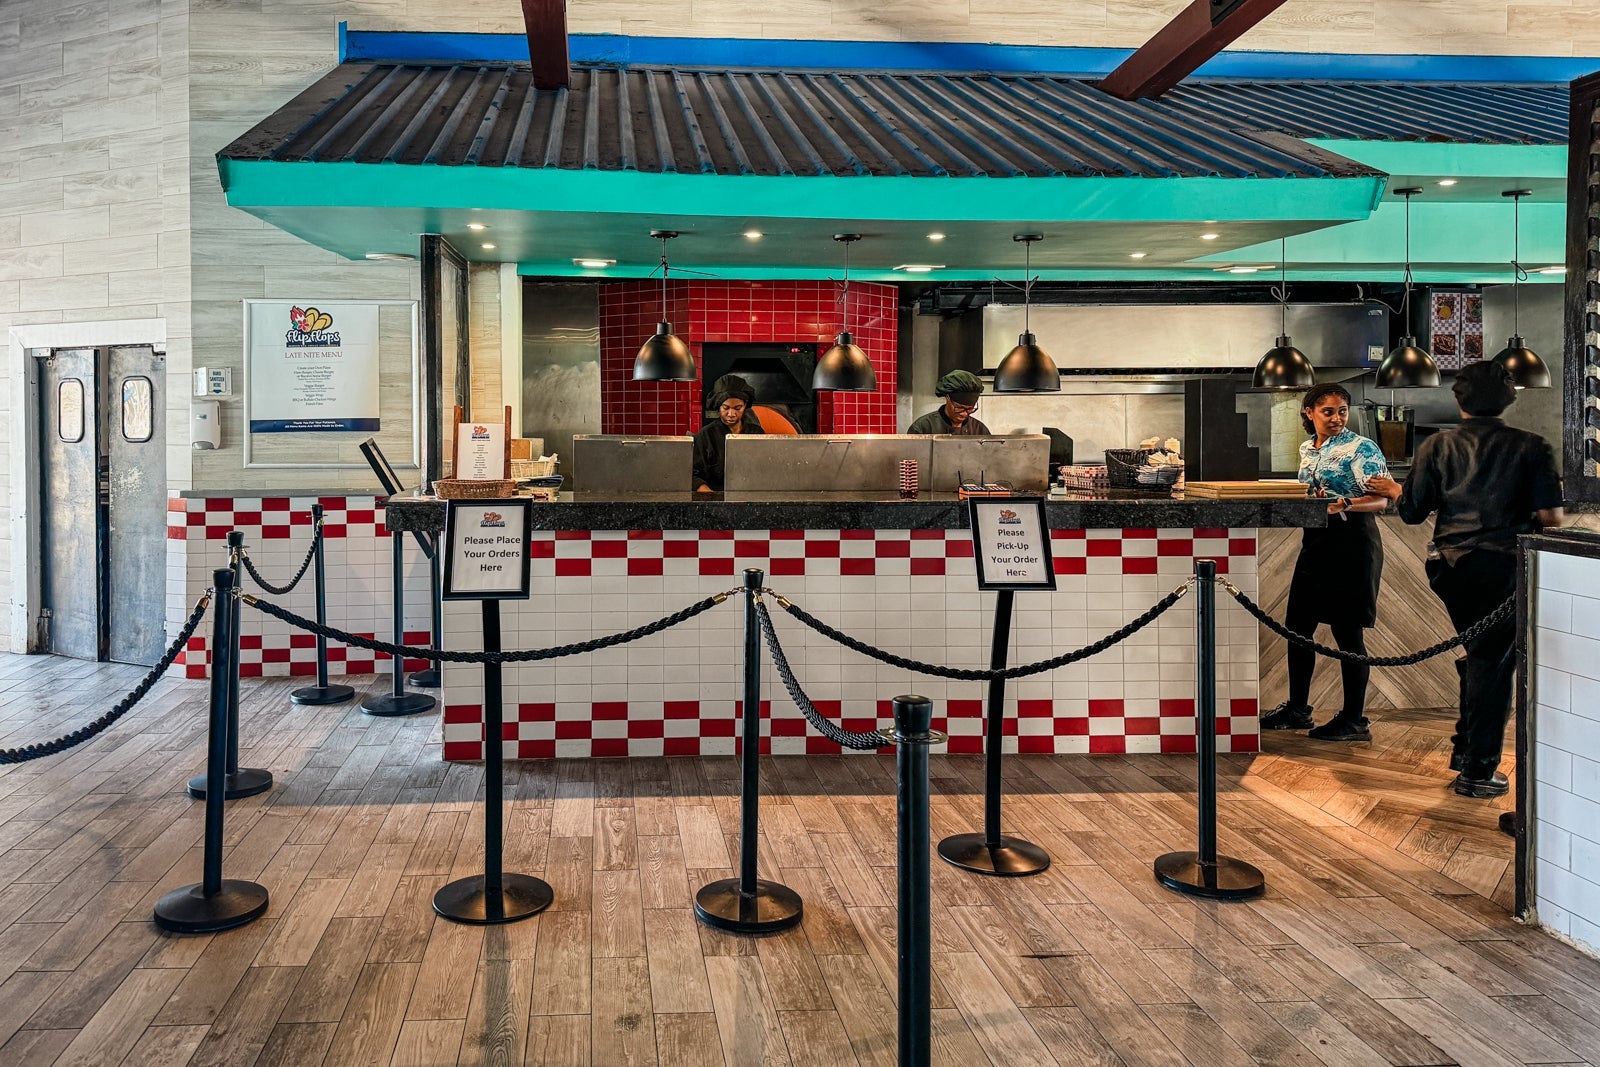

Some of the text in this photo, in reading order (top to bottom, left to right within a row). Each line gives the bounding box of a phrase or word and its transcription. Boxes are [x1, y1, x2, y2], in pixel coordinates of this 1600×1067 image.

[464, 536, 521, 544] Please Place
[997, 542, 1029, 551] Pick-Up
[464, 549, 520, 558] Your Orders
[1013, 555, 1038, 563] Order
[480, 564, 503, 572] Here
